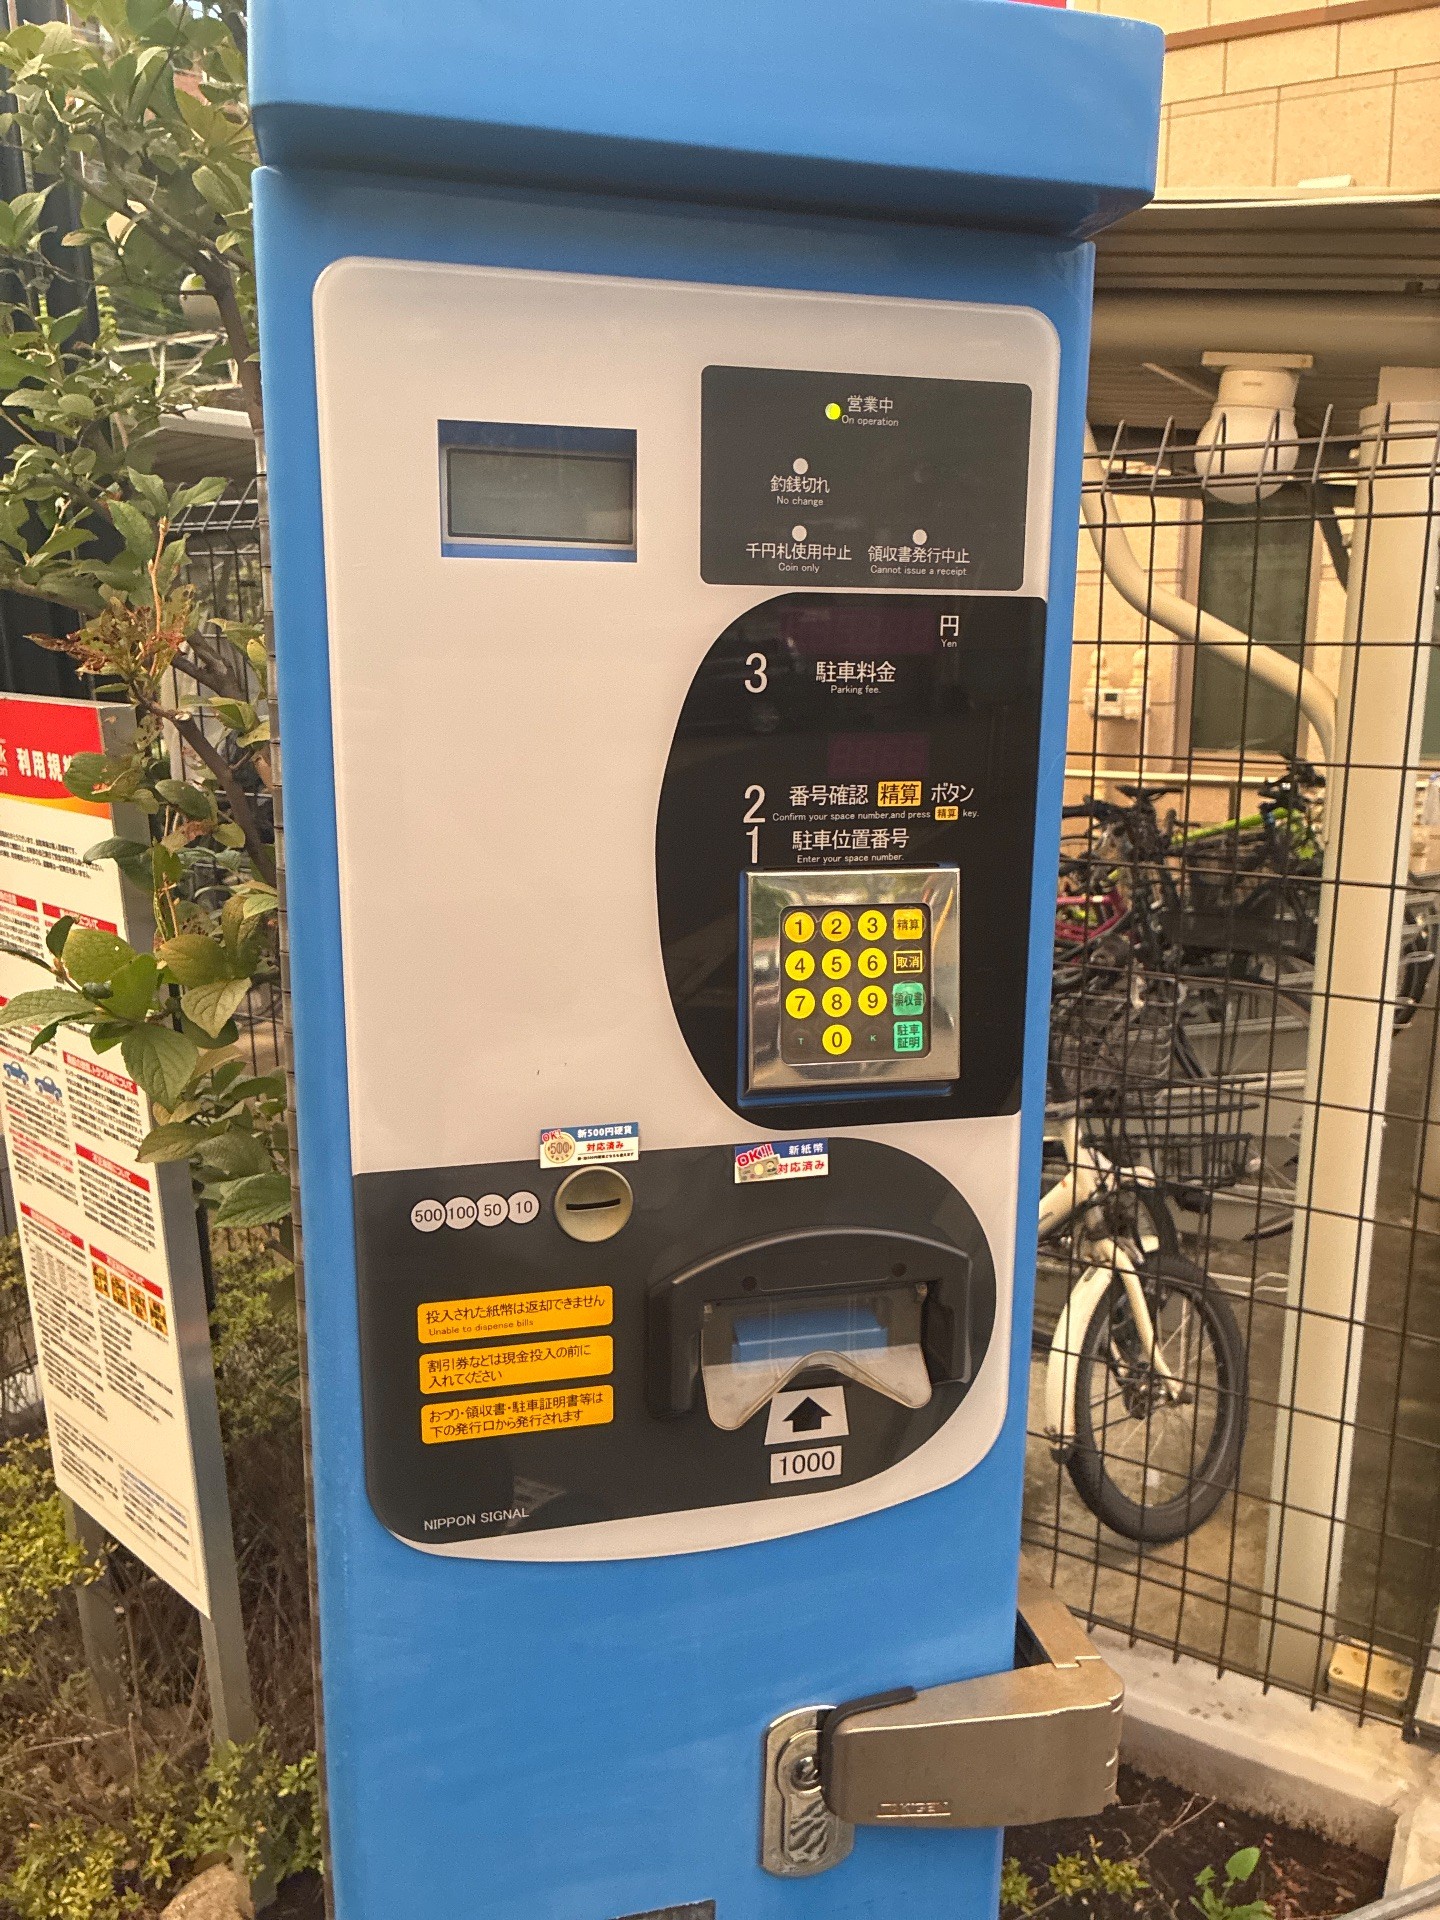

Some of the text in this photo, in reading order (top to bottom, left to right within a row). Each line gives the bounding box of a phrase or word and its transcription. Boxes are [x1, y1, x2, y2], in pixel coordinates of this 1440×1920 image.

[847, 394, 894, 414] 営業中
[841, 415, 899, 427] On operation
[770, 475, 830, 494] 釣銭切れ
[776, 496, 824, 507] No change
[745, 542, 852, 561] 千円札使用中止
[868, 545, 971, 564] 領収書発行中止
[778, 562, 820, 574] Coin only
[870, 564, 967, 577] Cannot issue a receipt
[939, 615, 960, 637] 円
[941, 639, 958, 648] Yen
[744, 652, 768, 693] 3
[815, 660, 896, 683] 駐車料金
[830, 685, 881, 695] Parking fee.
[743, 784, 766, 823] 2
[789, 783, 974, 807] 番号確認 精算 ボタン
[772, 812, 806, 822] Confirm
[809, 813, 827, 822] your
[830, 812, 855, 822] space
[907, 811, 931, 821] press
[937, 808, 957, 819] 精算
[962, 808, 980, 819] key.
[745, 825, 758, 864] 1
[792, 828, 910, 851] 駐車位置番号
[797, 852, 905, 865] Enter your space number.
[795, 918, 920, 935] 1 2 3 精算
[794, 955, 920, 973] 4 5 6 取消
[795, 992, 923, 1012] 7 8 9 領収書
[897, 1023, 920, 1036] 駐車
[831, 1031, 843, 1048] 0
[870, 1034, 877, 1042] K
[897, 1036, 920, 1049] 証明
[577, 1125, 632, 1138] 新500円硬貨
[550, 1142, 570, 1155] 500
[587, 1141, 624, 1152] 対応済み
[789, 1143, 823, 1155] 新紙幣
[777, 1160, 825, 1174] 対応済み
[415, 1200, 533, 1223] 500 100 50 10
[426, 1294, 605, 1324] 投入された紙幣は返却できません
[428, 1318, 534, 1336] Unable to dispense bills
[427, 1344, 591, 1373] 割引券などは現金投入の前に
[429, 1370, 503, 1389] 入れてください
[429, 1392, 603, 1424] おつり・領収書・駐車証明書等は
[430, 1409, 583, 1439] 下の発行口から発行されます
[779, 1450, 835, 1476] 1000
[424, 1507, 530, 1531] NIPPON SIGNAL
